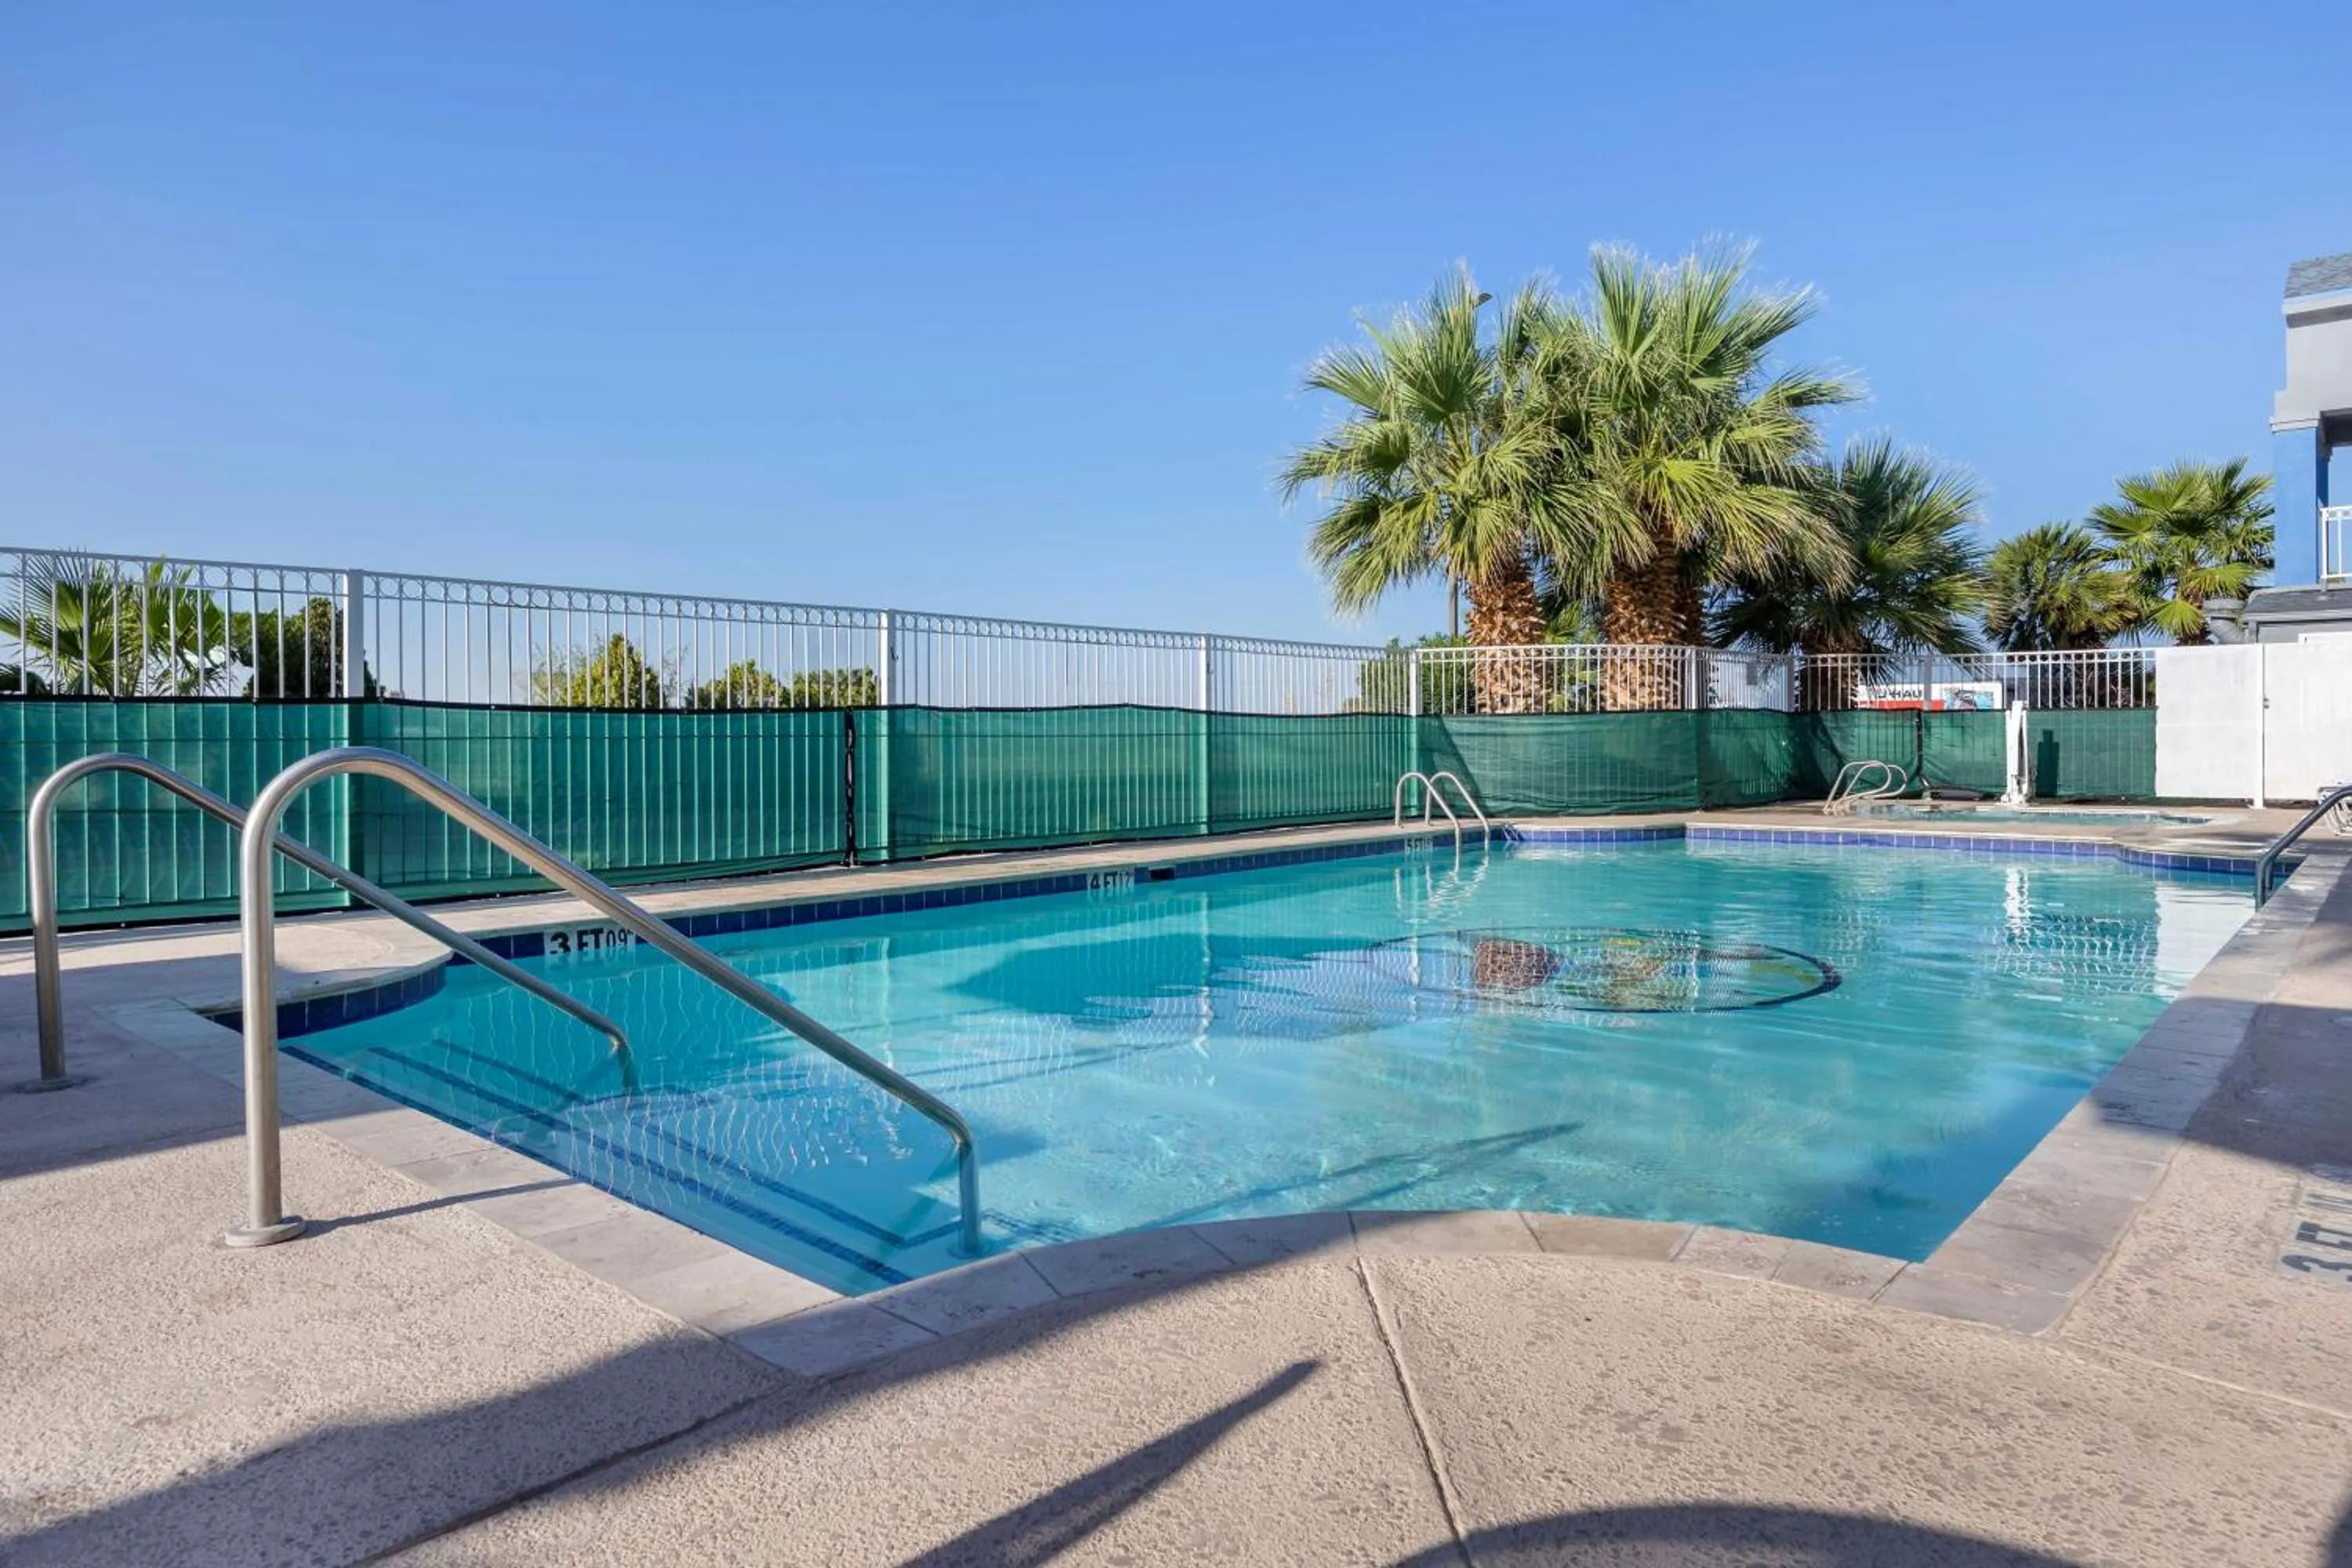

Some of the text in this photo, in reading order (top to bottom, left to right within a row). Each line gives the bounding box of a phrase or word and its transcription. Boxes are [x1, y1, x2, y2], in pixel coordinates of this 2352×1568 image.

[1090, 871, 1102, 890] 4
[1103, 870, 1118, 888] FT
[550, 931, 572, 954] 3
[576, 927, 604, 952] FT
